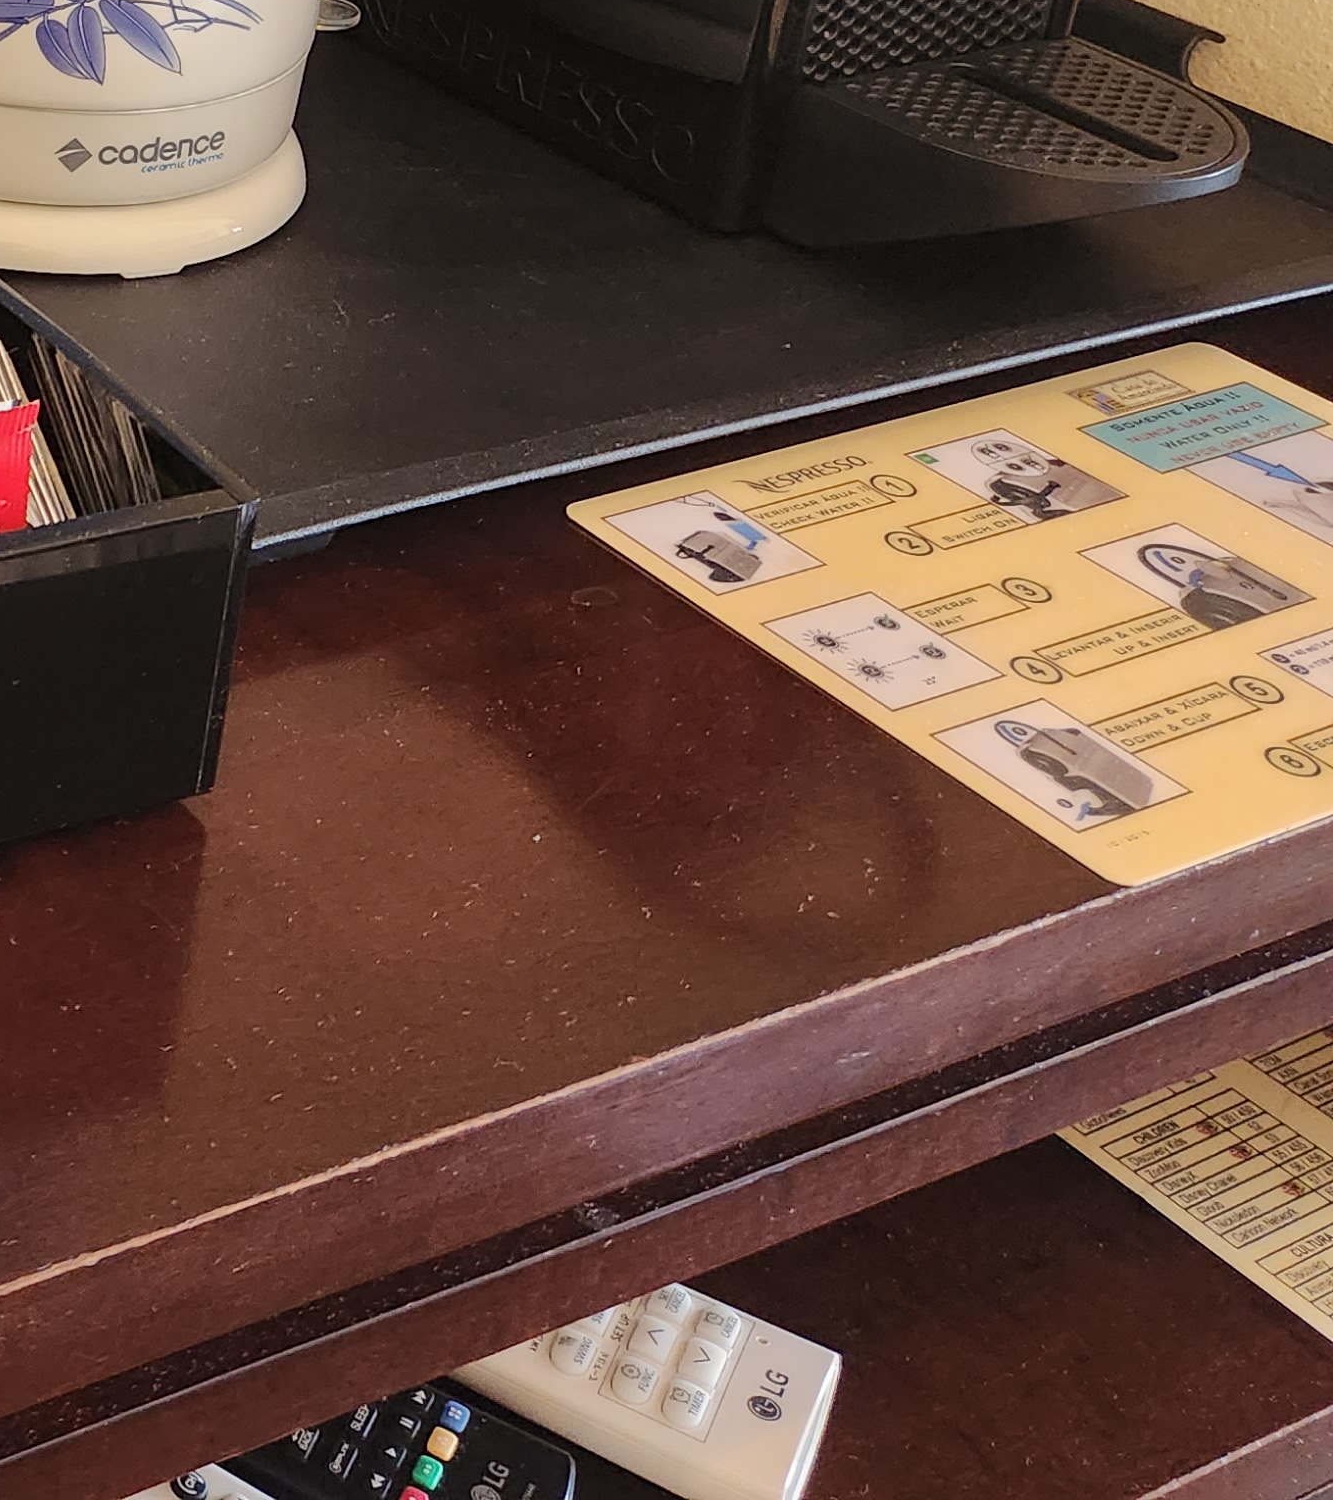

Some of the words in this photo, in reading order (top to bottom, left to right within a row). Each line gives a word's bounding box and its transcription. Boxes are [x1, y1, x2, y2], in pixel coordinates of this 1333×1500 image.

[97, 130, 226, 165] cadence
[141, 161, 185, 174] ceramic
[188, 152, 224, 168] thermo
[1109, 407, 1183, 433] SOMENTE
[1184, 396, 1225, 413] ÁGUA
[1159, 430, 1212, 450] WATER
[1213, 417, 1251, 436] ONLY
[732, 455, 868, 494] NESPRESSO
[754, 499, 820, 521] VERIFICAR
[822, 490, 858, 505] ÁGUA
[769, 514, 814, 530] CHECK
[815, 501, 861, 519] WATER
[960, 508, 1004, 525] LIGAR
[897, 536, 921, 551] 2
[941, 524, 994, 544] SWITCH
[995, 517, 1019, 531] ON
[1013, 582, 1038, 597] 3
[913, 595, 979, 620] ESPERAR
[929, 613, 966, 630] WAIT
[1024, 662, 1050, 679] 4
[1244, 681, 1268, 697] 5
[1133, 1119, 1181, 1146] CHILDREN
[765, 1368, 789, 1398] LG
[687, 1390, 706, 1417] TIMER
[491, 1461, 510, 1489] LG
